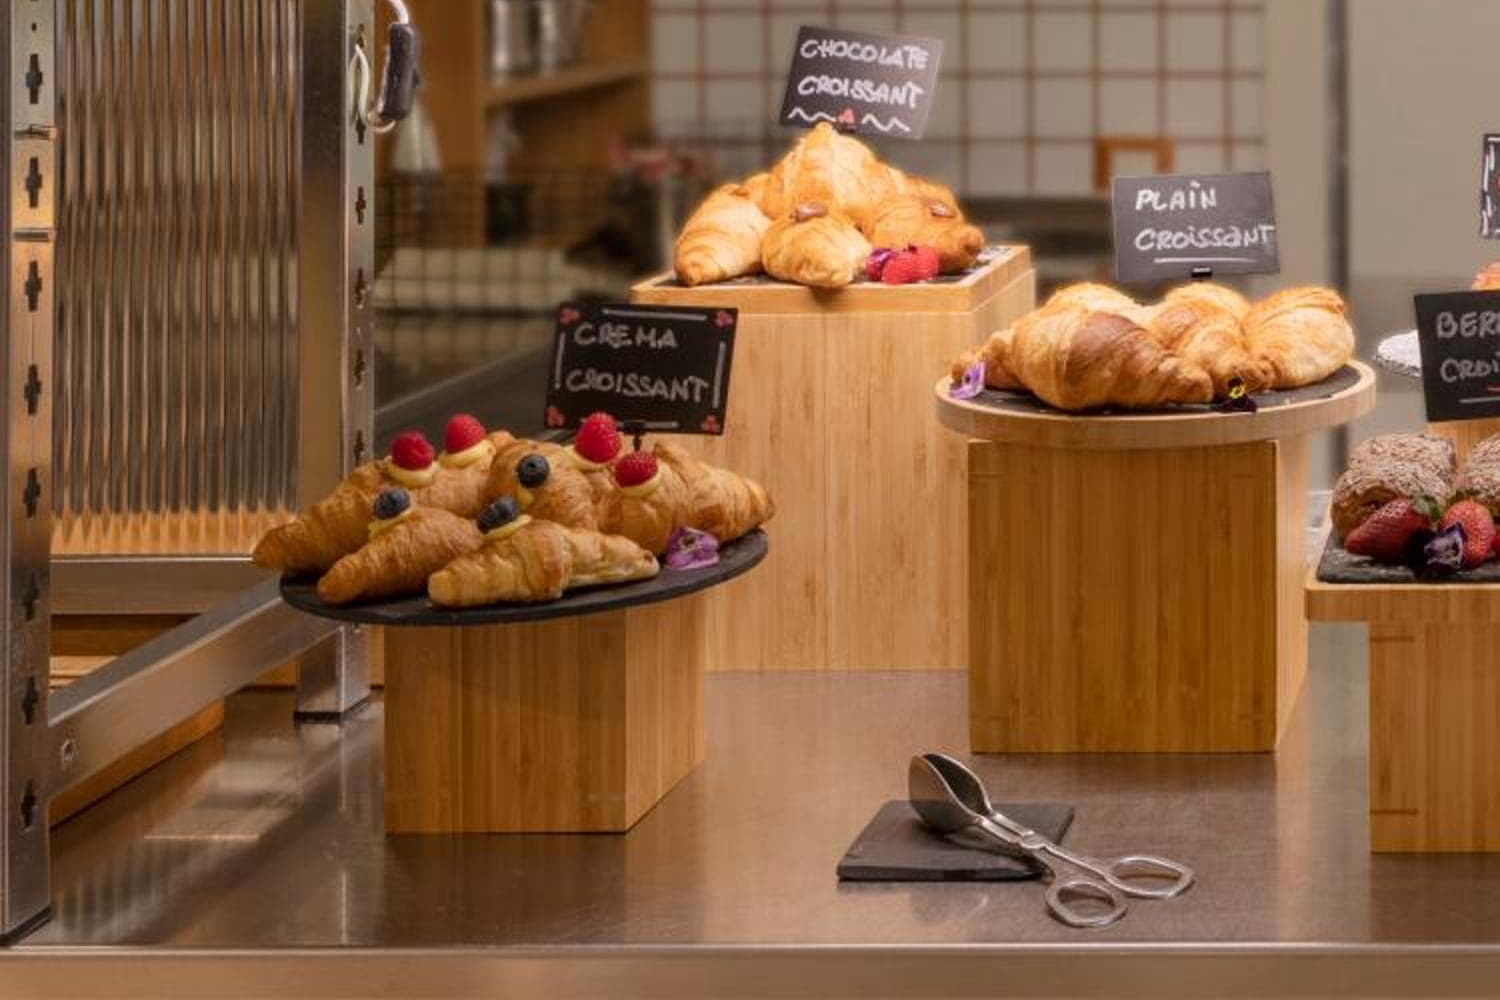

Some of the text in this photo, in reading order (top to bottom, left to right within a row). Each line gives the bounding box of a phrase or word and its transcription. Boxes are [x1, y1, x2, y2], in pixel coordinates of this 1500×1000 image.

[801, 39, 929, 69] CHOCOLATE
[797, 75, 924, 109] CROISSANT
[574, 321, 678, 349] CREMA
[566, 368, 709, 403] CROISSANT
